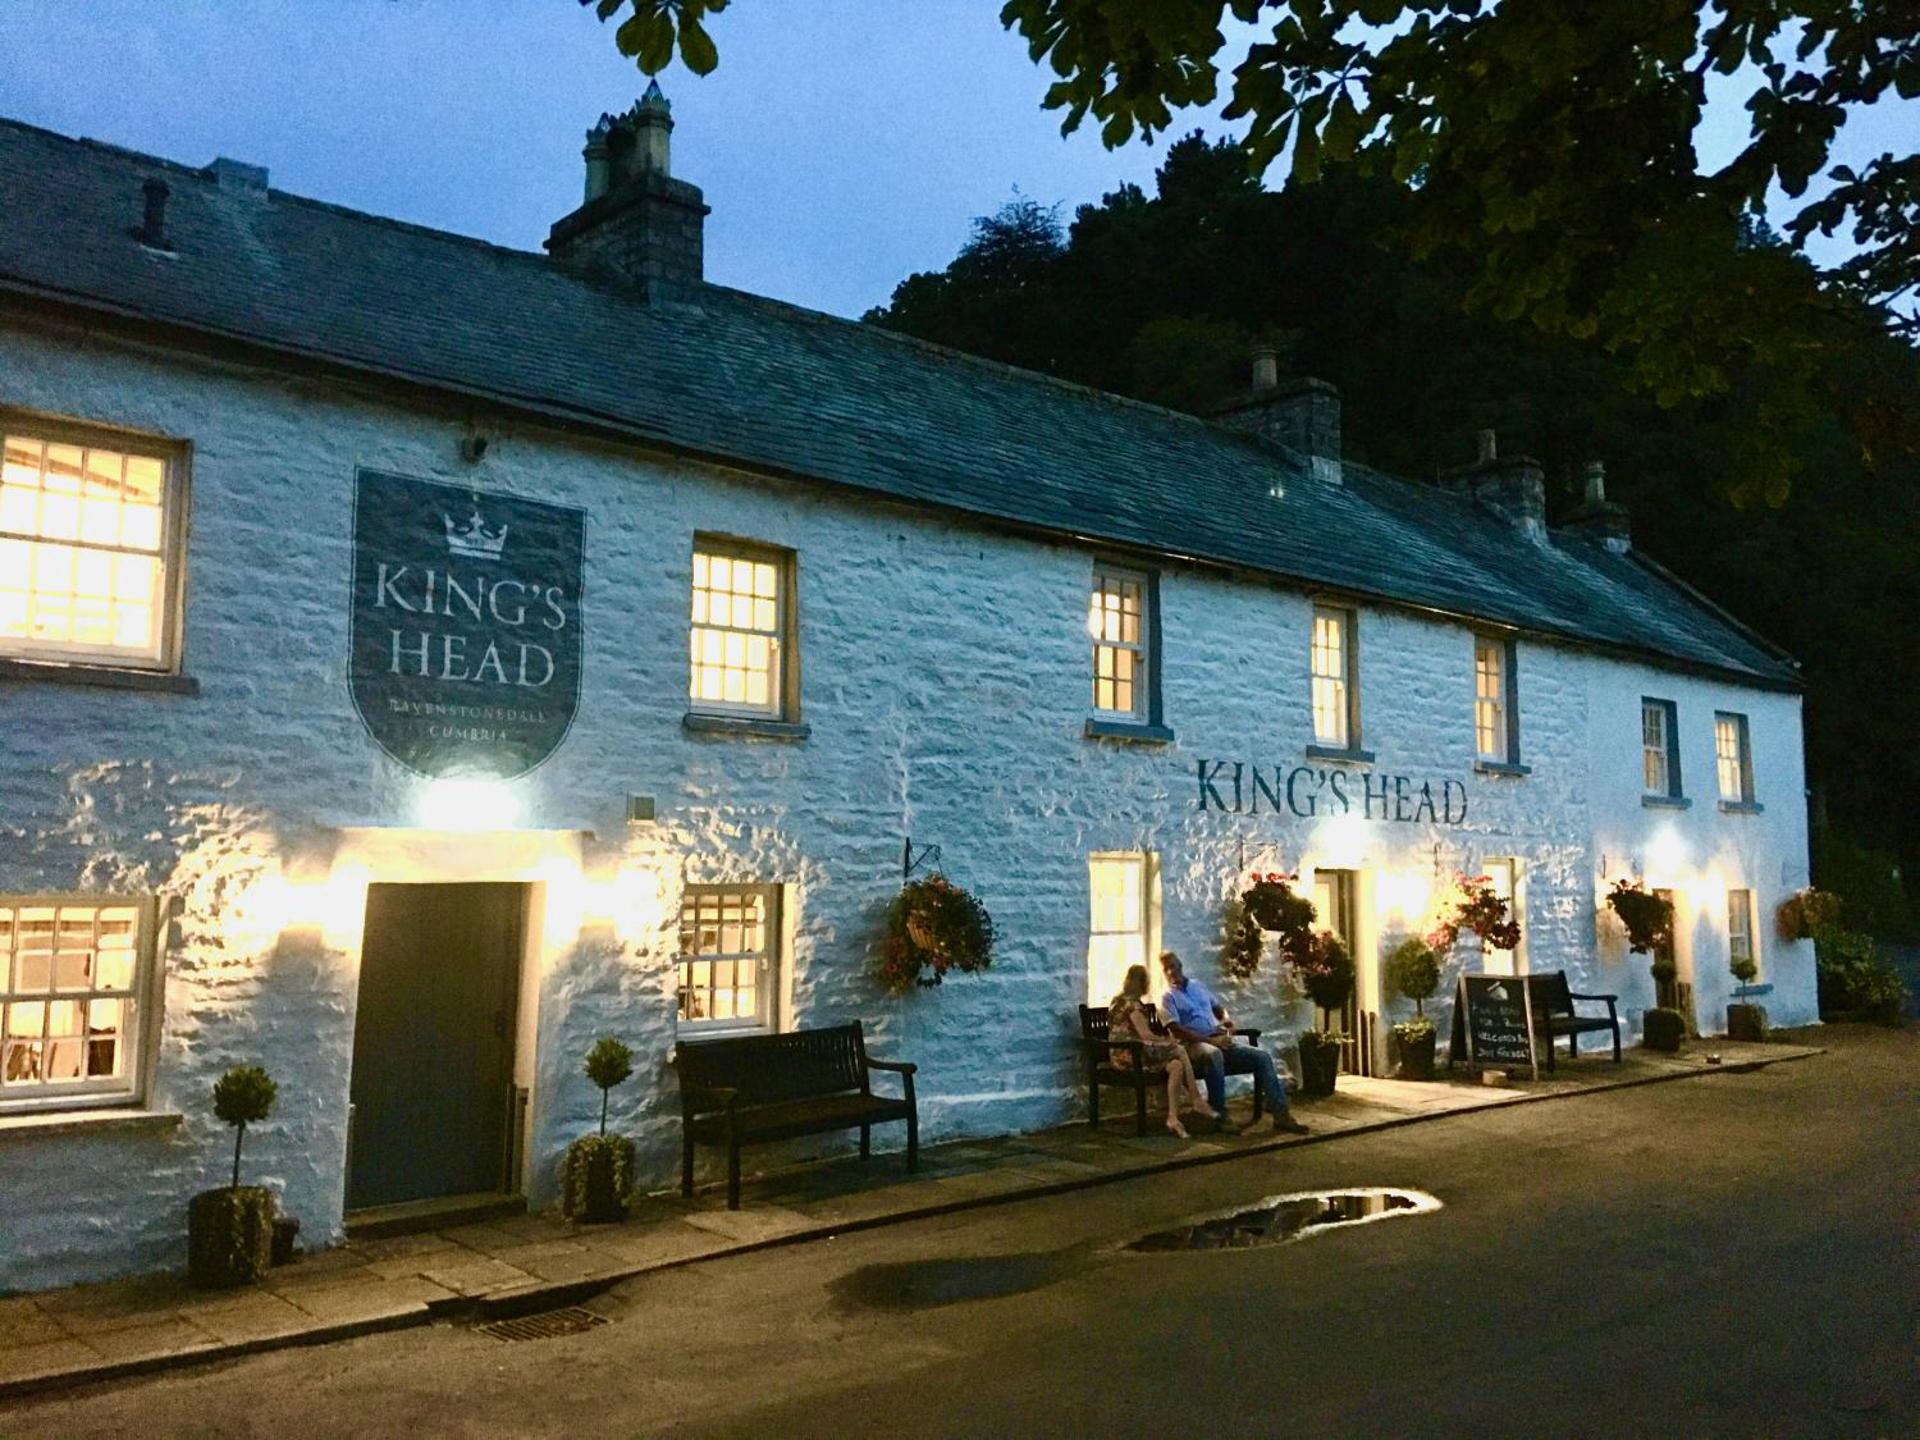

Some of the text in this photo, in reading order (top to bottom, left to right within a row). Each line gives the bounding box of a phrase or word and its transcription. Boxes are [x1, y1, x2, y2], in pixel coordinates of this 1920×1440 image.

[375, 562, 567, 630] KING'S
[389, 628, 555, 687] HEAD
[429, 724, 507, 741] CUMBRIA
[1196, 759, 1468, 825] KING'S HEAD
